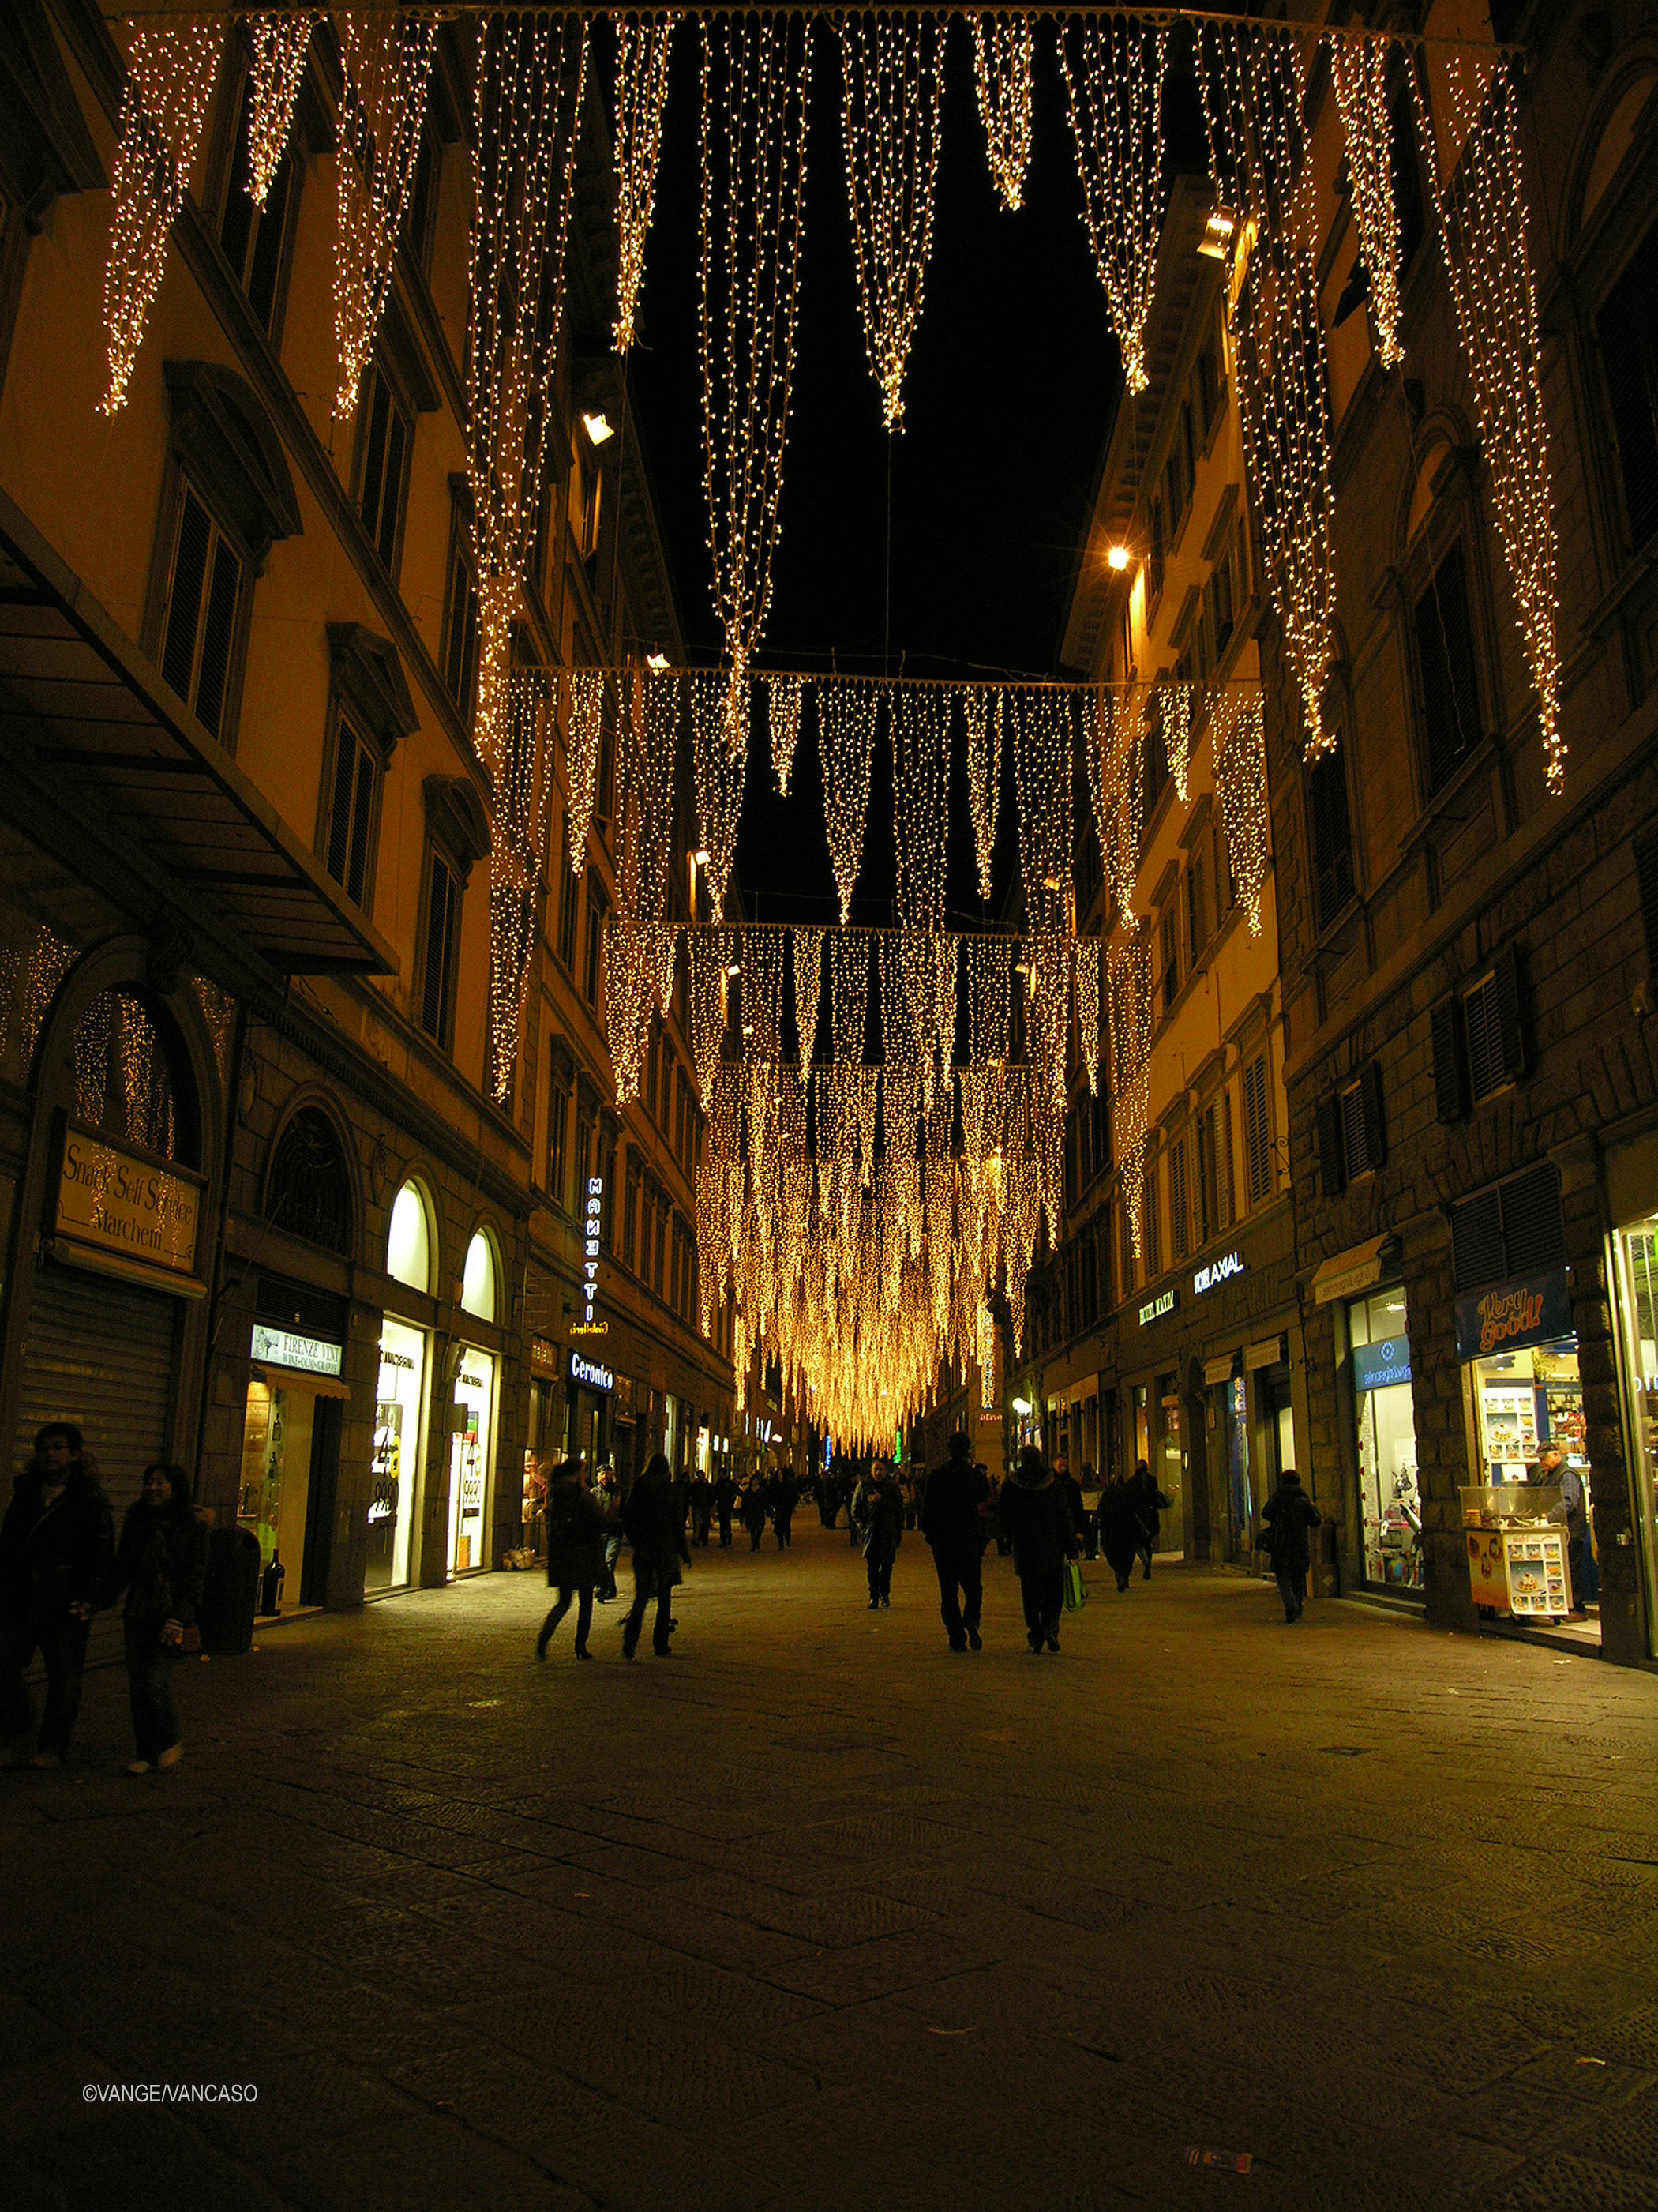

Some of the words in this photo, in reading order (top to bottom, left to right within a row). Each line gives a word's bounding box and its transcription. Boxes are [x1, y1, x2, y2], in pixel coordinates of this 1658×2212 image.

[63, 1144, 110, 1194] Snack
[114, 1165, 144, 1207] Self
[144, 1177, 193, 1225] Service
[1210, 1251, 1244, 1286] AXIAL
[283, 1335, 320, 1358] FIRENZE
[322, 1344, 339, 1363] VINI
[571, 1353, 613, 1390] Ceronico
